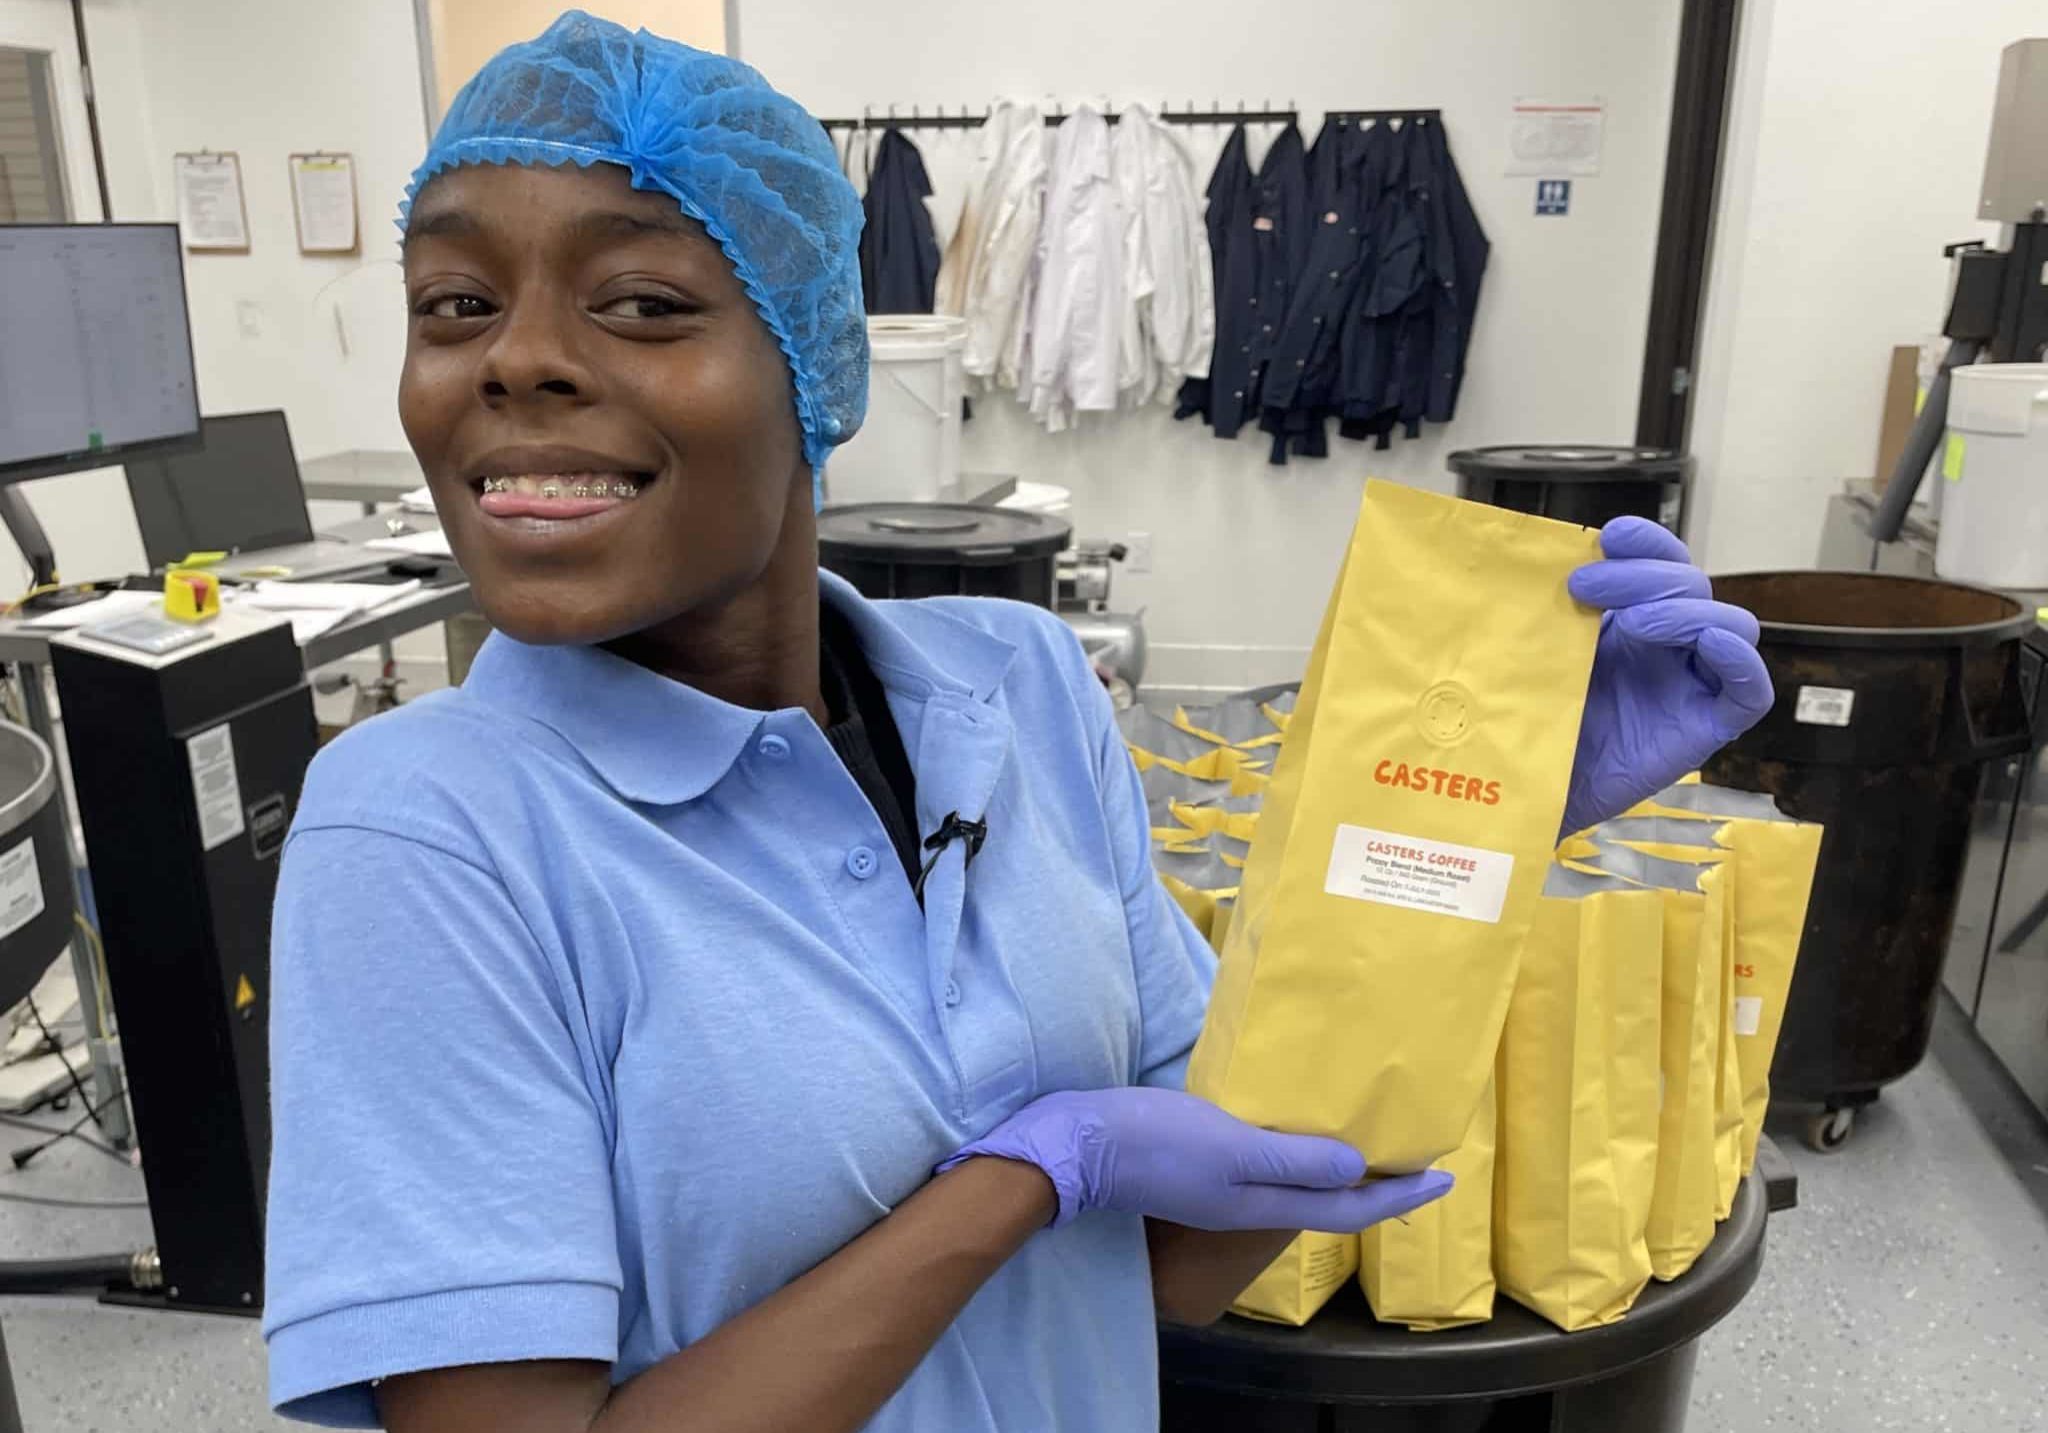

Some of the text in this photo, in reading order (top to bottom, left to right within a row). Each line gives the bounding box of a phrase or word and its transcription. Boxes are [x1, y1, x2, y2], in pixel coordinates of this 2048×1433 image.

[1374, 759, 1501, 806] CASTERS
[1366, 841, 1477, 872] CASTERS COFFEE
[1413, 864, 1445, 877] (Medium
